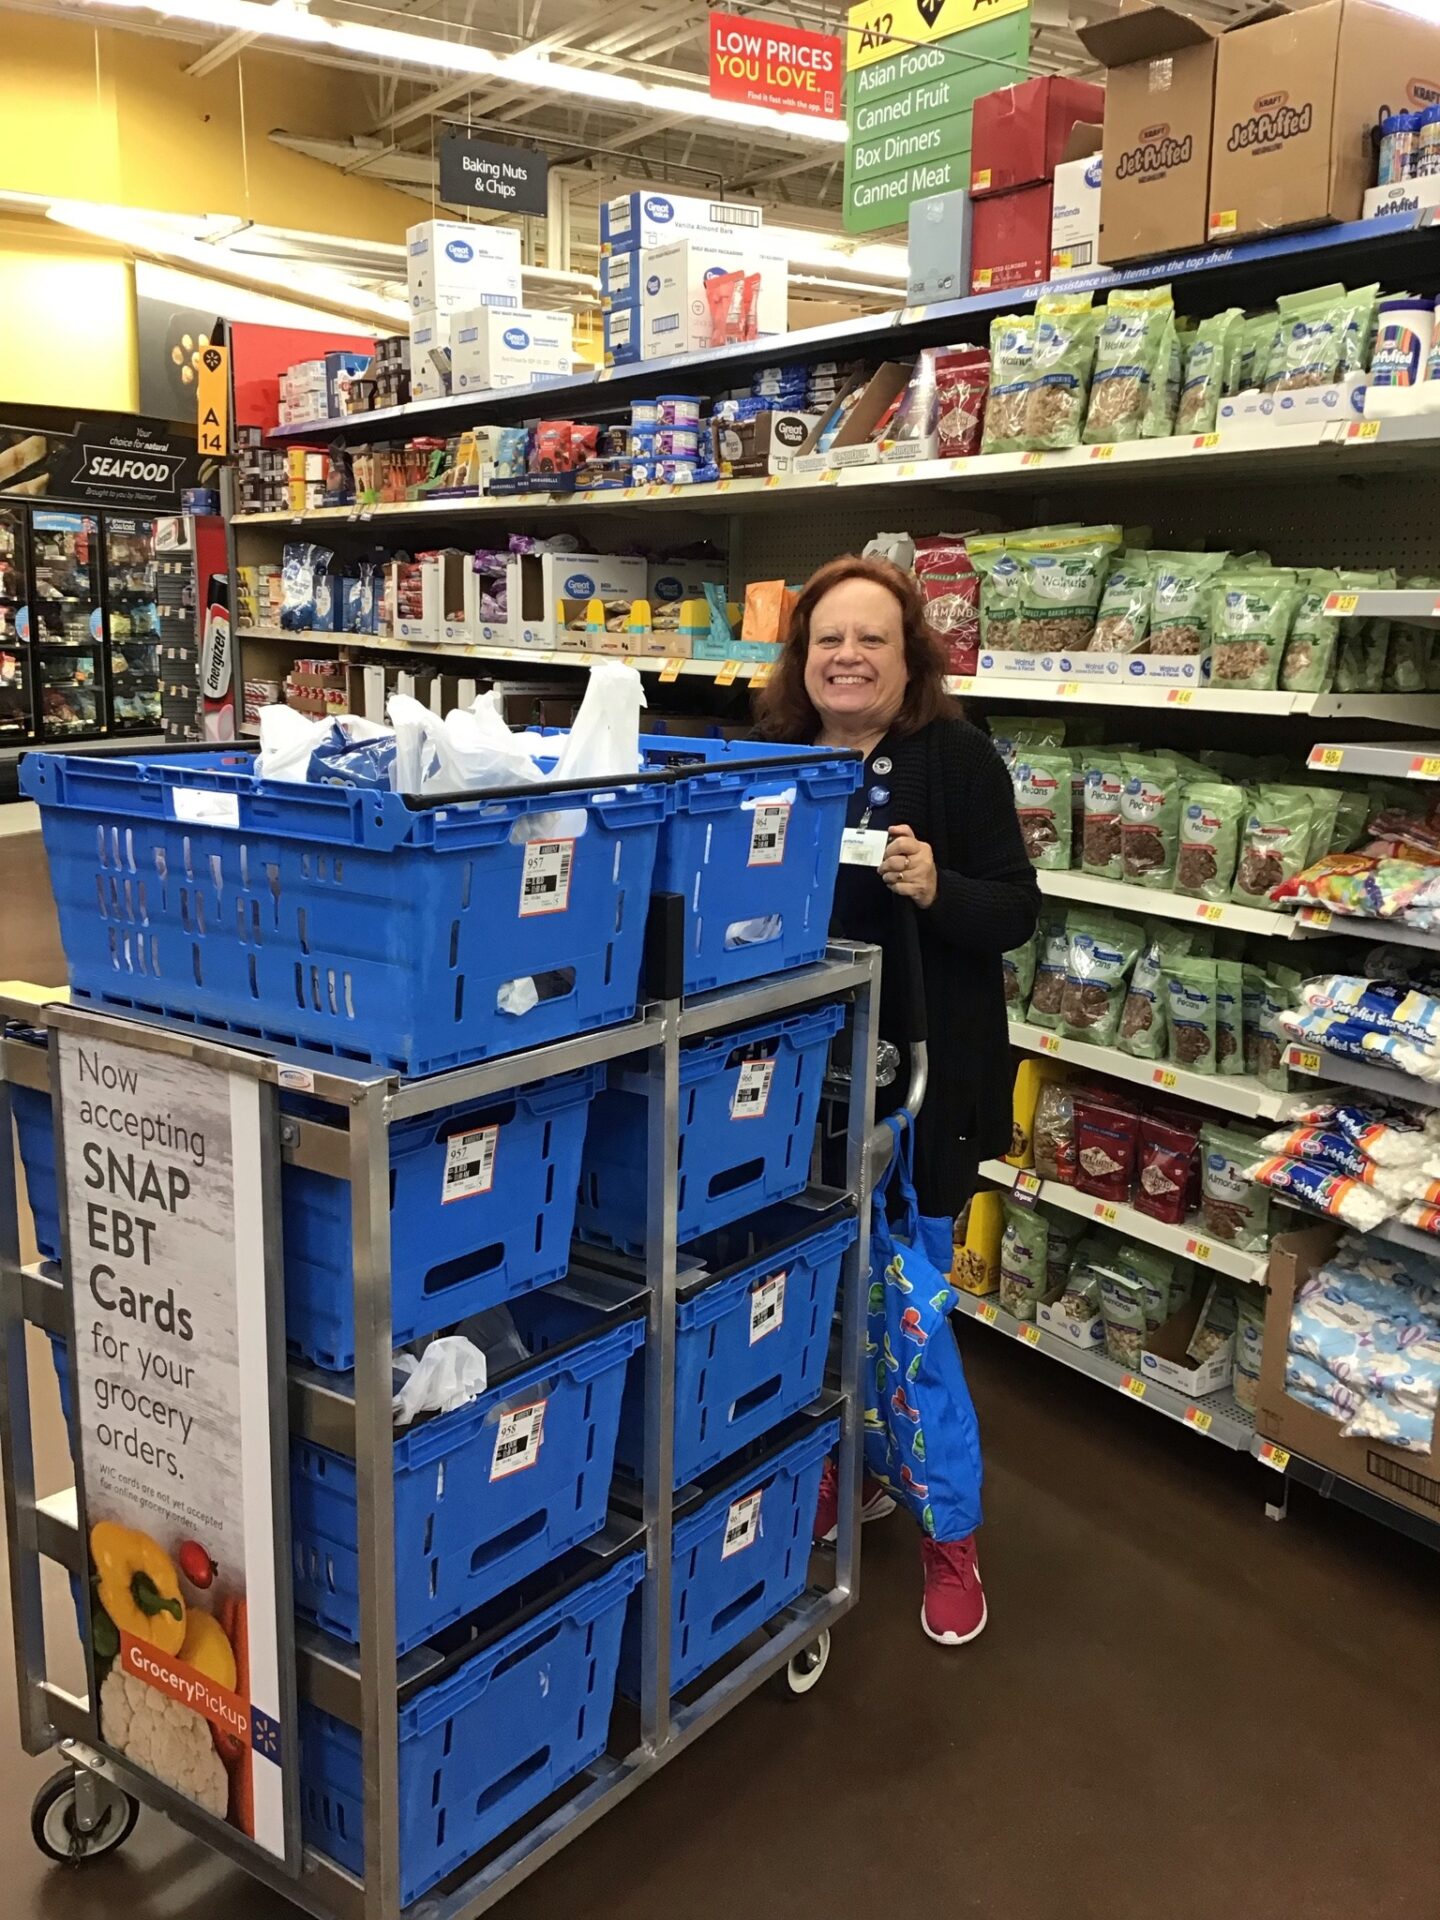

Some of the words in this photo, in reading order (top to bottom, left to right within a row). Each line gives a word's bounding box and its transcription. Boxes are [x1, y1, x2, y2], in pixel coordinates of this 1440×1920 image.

[858, 13, 893, 54] A12
[716, 29, 762, 59] LOW
[766, 39, 833, 72] PRICES
[715, 54, 760, 82] YOU
[766, 66, 821, 93] LOVE.
[858, 64, 896, 94] Asian
[900, 43, 945, 79] Foods
[747, 90, 762, 100] Find
[762, 93, 768, 102] it
[769, 94, 782, 104] fast
[782, 98, 796, 106] with
[797, 100, 807, 108] the
[857, 96, 911, 131] Canned
[915, 84, 950, 116] Fruit
[1258, 95, 1282, 107] KRAFT
[855, 146, 881, 170] Box
[884, 128, 941, 161] Dinners
[462, 156, 500, 178] Baking
[502, 163, 528, 180] Nuts
[475, 177, 484, 191] &
[485, 179, 516, 198] Chips
[854, 172, 908, 207] Canned
[911, 163, 951, 192] Meat
[647, 200, 669, 211] Great
[1054, 208, 1080, 219] Almonds
[675, 221, 695, 230] Vanilla
[696, 225, 719, 233] Almond
[720, 227, 733, 235] Bark
[449, 245, 469, 255] Great
[1022, 289, 1039, 299] Ask
[1040, 285, 1053, 296] for
[1053, 277, 1100, 294] assistance
[1101, 272, 1122, 285] with
[1123, 268, 1150, 281] items
[1151, 264, 1165, 275] on
[1166, 260, 1183, 272] the
[1184, 257, 1204, 271] top
[1205, 250, 1233, 265] shelf.
[506, 332, 526, 343] Great
[203, 407, 219, 427] A
[136, 428, 152, 438] Your
[778, 422, 803, 435] Great
[784, 432, 802, 441] Value
[109, 436, 133, 448] choice
[133, 438, 146, 449] for
[144, 443, 170, 452] natural
[201, 433, 222, 451] 14
[89, 456, 169, 482] SEAFOOD
[85, 487, 108, 498] Brought
[116, 491, 126, 499] you
[568, 580, 589, 589] Great
[1042, 575, 1087, 588] Walnuts
[207, 628, 225, 690] Energizer
[1015, 658, 1035, 666] Walnut
[1022, 786, 1048, 796] Pecans
[528, 856, 544, 869] 957
[1176, 998, 1199, 1010] Pecans
[1304, 1055, 1318, 1068] 2.24
[78, 1048, 138, 1095] Now
[80, 1100, 205, 1167] accepting
[450, 1147, 467, 1160] 957
[83, 1142, 191, 1213] SNAP
[1209, 1173, 1241, 1192] Almonds
[1014, 1191, 1033, 1203] Organic
[87, 1202, 157, 1265] EBT
[89, 1264, 193, 1341] Cards
[91, 1321, 130, 1362] for
[138, 1347, 194, 1389] your
[94, 1378, 193, 1445] grocery
[97, 1423, 185, 1480] orders.
[100, 1464, 116, 1479] WIC
[118, 1474, 140, 1490] cards
[141, 1484, 155, 1497] are
[157, 1491, 170, 1504] not
[173, 1499, 185, 1511] yet
[186, 1506, 223, 1530] accepted
[100, 1477, 112, 1490] for
[114, 1485, 138, 1503] online
[139, 1497, 171, 1520] grocery
